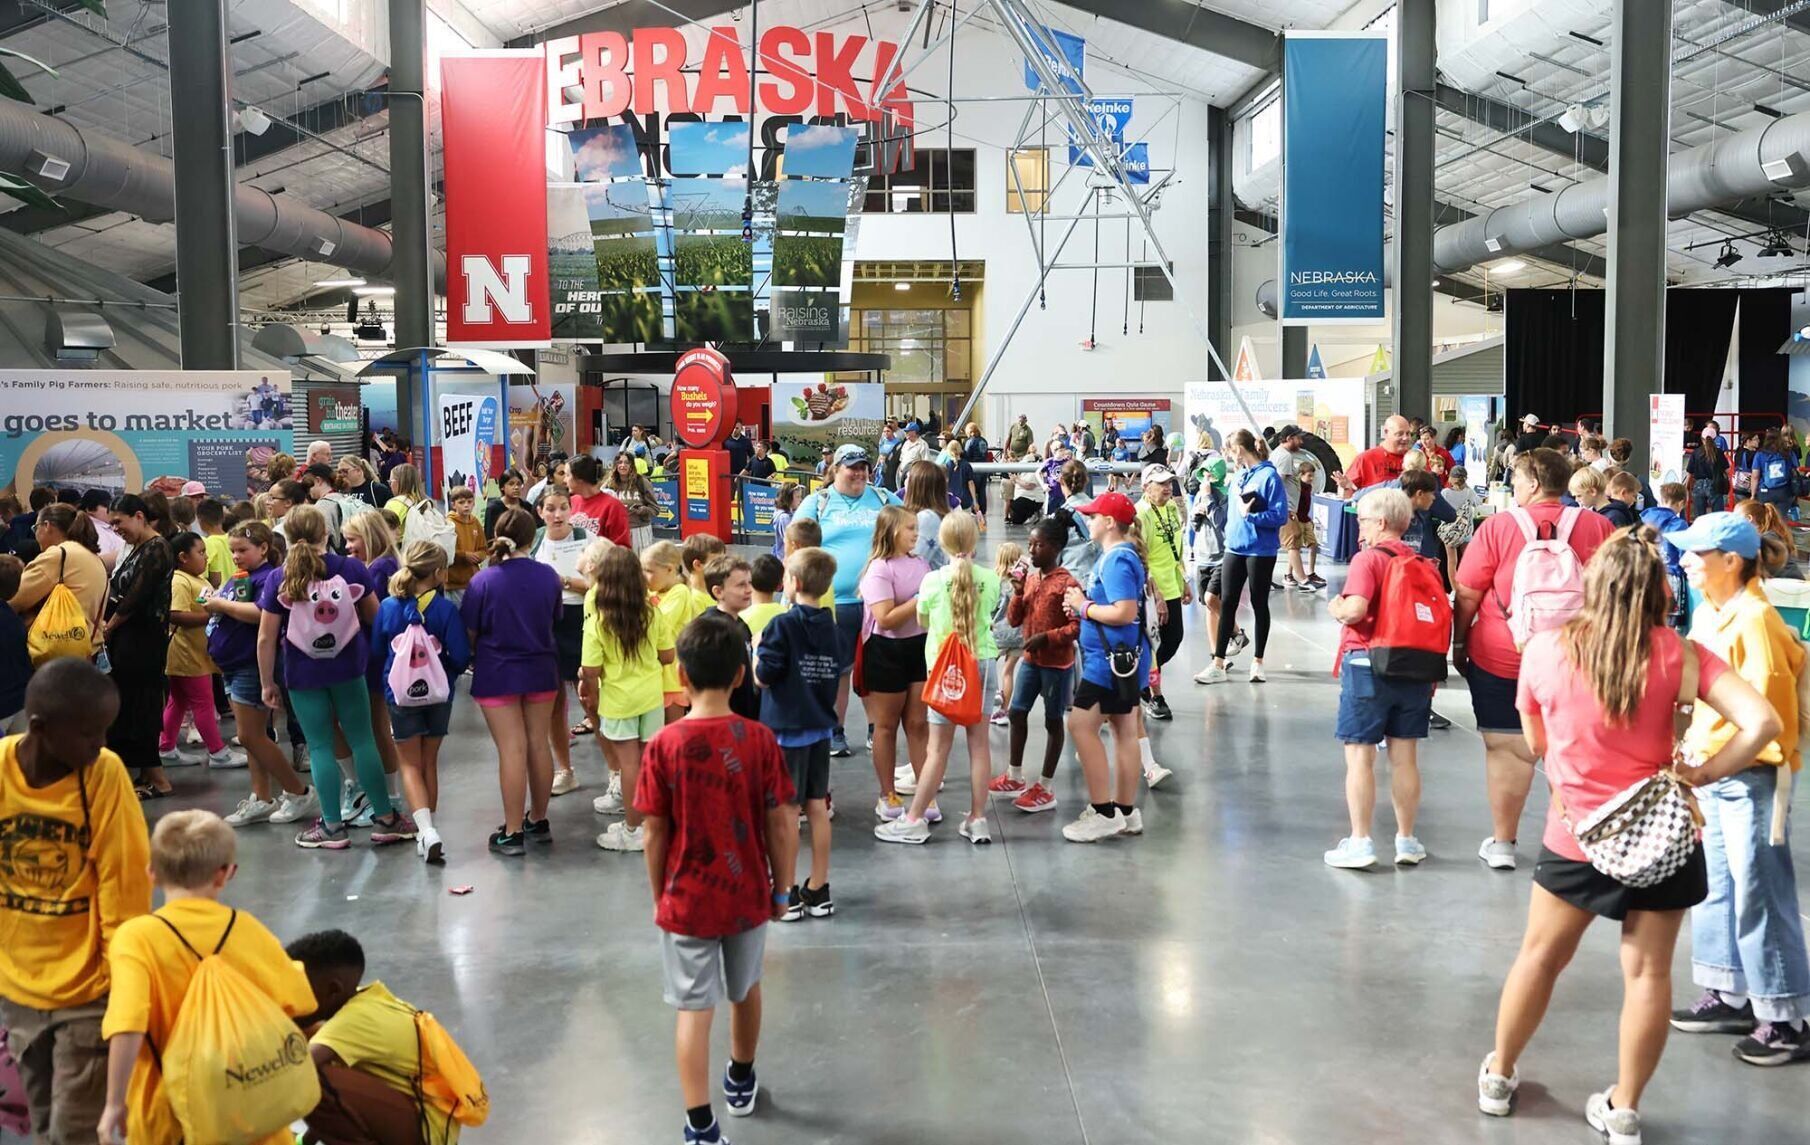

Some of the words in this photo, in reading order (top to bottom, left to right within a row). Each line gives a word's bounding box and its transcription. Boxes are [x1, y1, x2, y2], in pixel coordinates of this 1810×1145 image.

[545, 26, 914, 127] EBRASKA
[1124, 159, 1147, 171] inke
[1290, 271, 1377, 284] NEBRASKA
[461, 254, 532, 325] N
[558, 280, 569, 290] TO
[570, 280, 585, 290] THE
[1290, 290, 1312, 298] Good
[1313, 290, 1329, 298] Life.
[1331, 290, 1352, 298] Great
[555, 303, 577, 314] OF
[579, 303, 602, 314] OU
[786, 318, 830, 326] Nebraska
[12, 380, 46, 390] Family
[49, 380, 65, 390] Pig
[68, 380, 111, 389] Farmers:
[114, 381, 149, 390] Raising
[151, 381, 173, 390] safe,
[175, 382, 219, 390] nutritious
[221, 382, 242, 391] pork
[681, 391, 708, 401] Bushels
[4, 414, 80, 439] goes
[86, 411, 117, 432] to
[124, 409, 233, 431] market
[443, 401, 473, 439] BEEF
[841, 418, 880, 427] NATURAL
[837, 426, 879, 436] resources
[236, 585, 247, 598] G
[409, 684, 428, 696] pork
[225, 1042, 289, 1090] Newell
